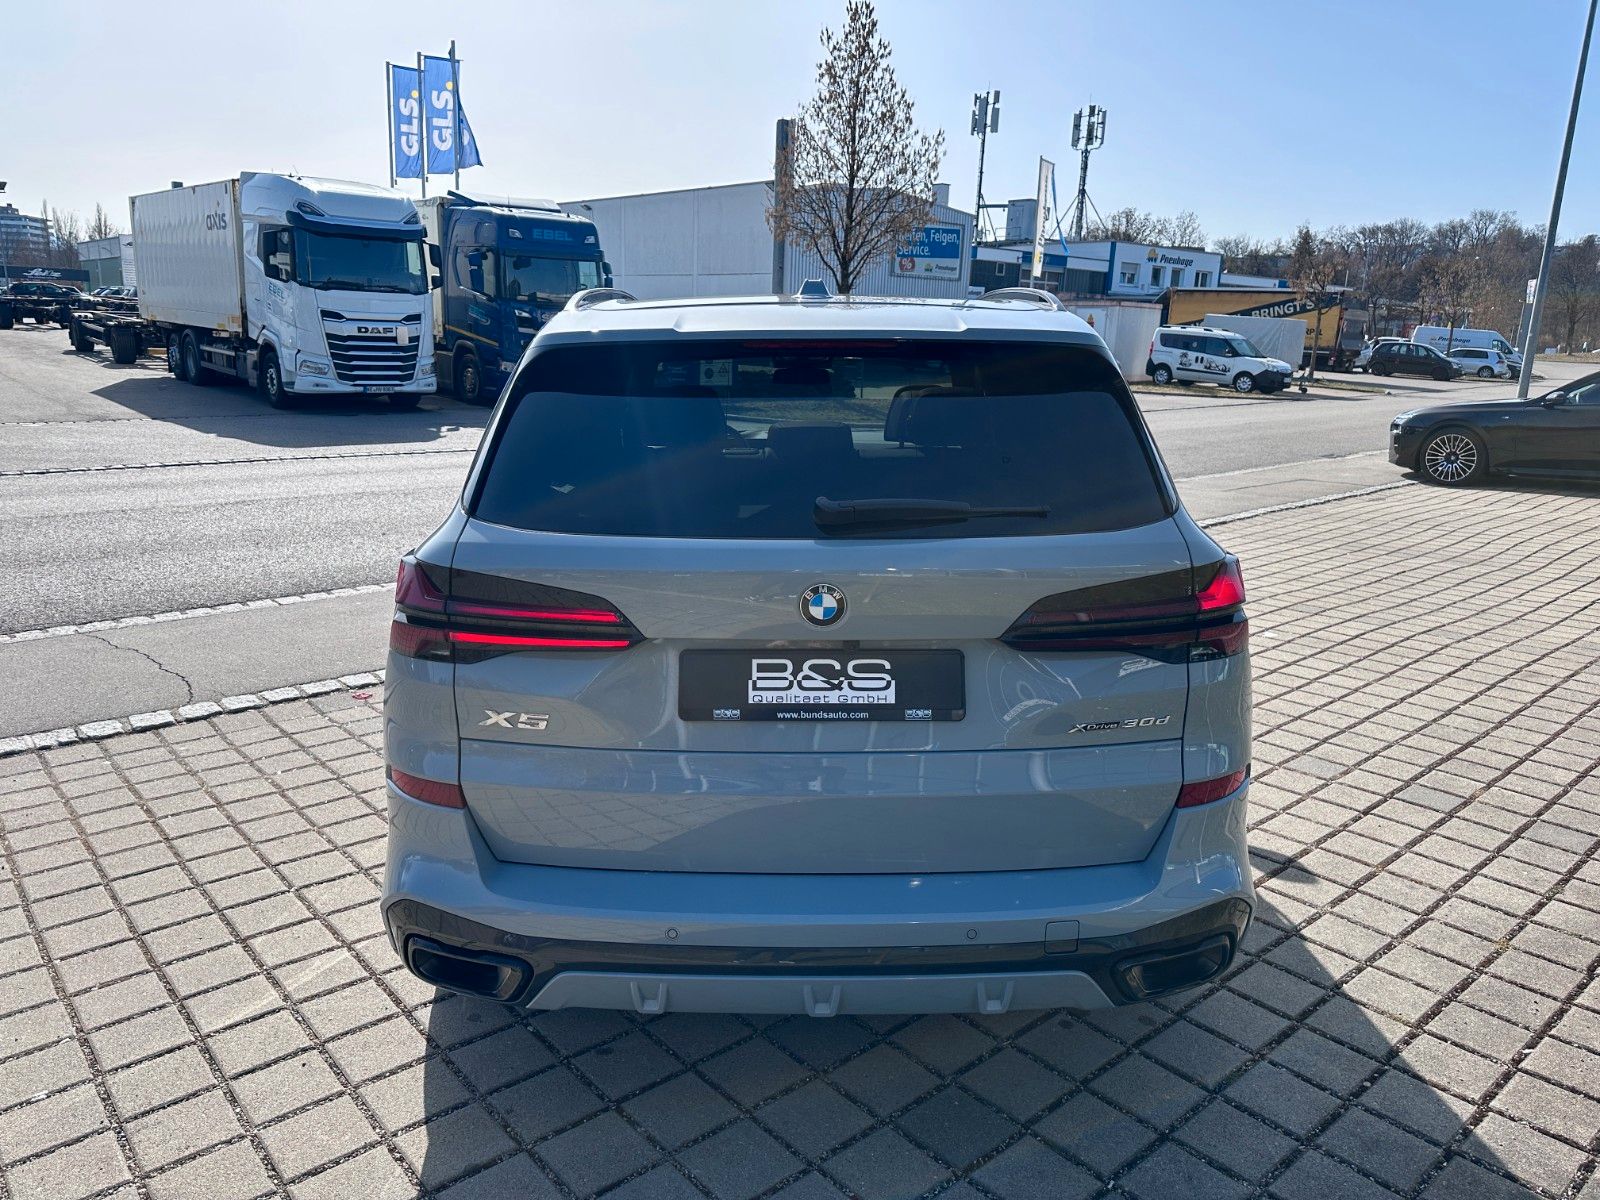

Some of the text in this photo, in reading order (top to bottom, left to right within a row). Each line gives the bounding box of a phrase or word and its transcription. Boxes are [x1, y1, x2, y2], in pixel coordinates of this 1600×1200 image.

[532, 228, 573, 240] EBEL
[930, 230, 959, 246] Felgen,
[1160, 254, 1194, 267] Pneuhage
[357, 326, 394, 335] DAF
[804, 585, 843, 600] BMW
[751, 658, 893, 692] B&S
[752, 694, 889, 704] Qualitaet GmbH
[478, 709, 550, 731] X5
[776, 710, 870, 720] www.bundsauto.com
[1122, 716, 1171, 729] 30d
